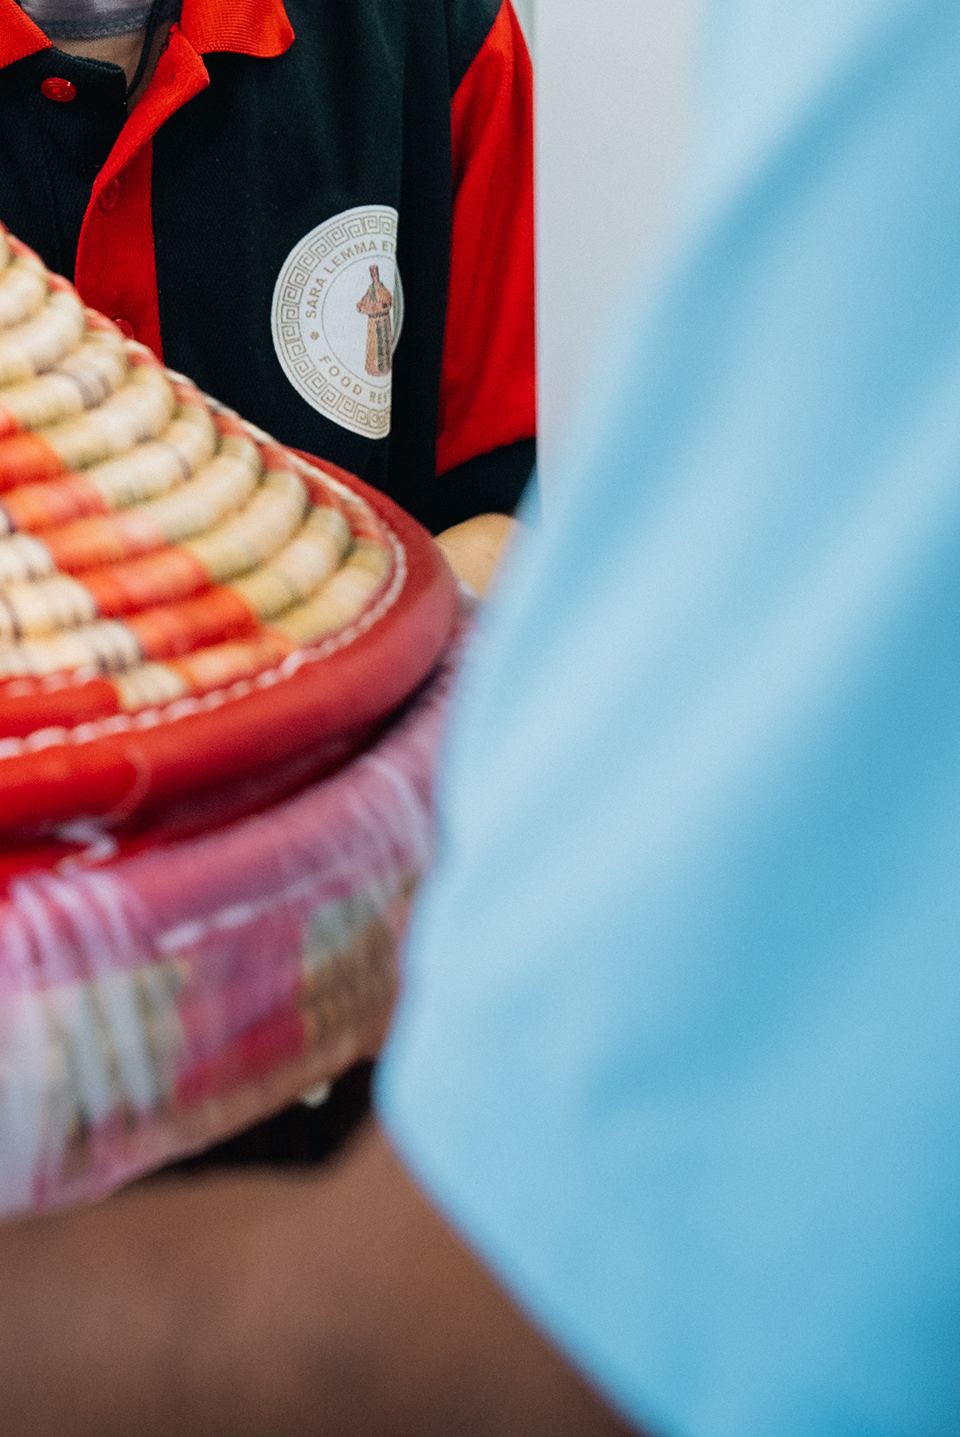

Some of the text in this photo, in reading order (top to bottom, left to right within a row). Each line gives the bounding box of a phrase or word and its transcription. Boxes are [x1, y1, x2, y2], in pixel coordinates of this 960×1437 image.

[305, 278, 327, 319] SARA
[324, 240, 377, 275] LEMMA
[319, 355, 363, 396] FOOD
